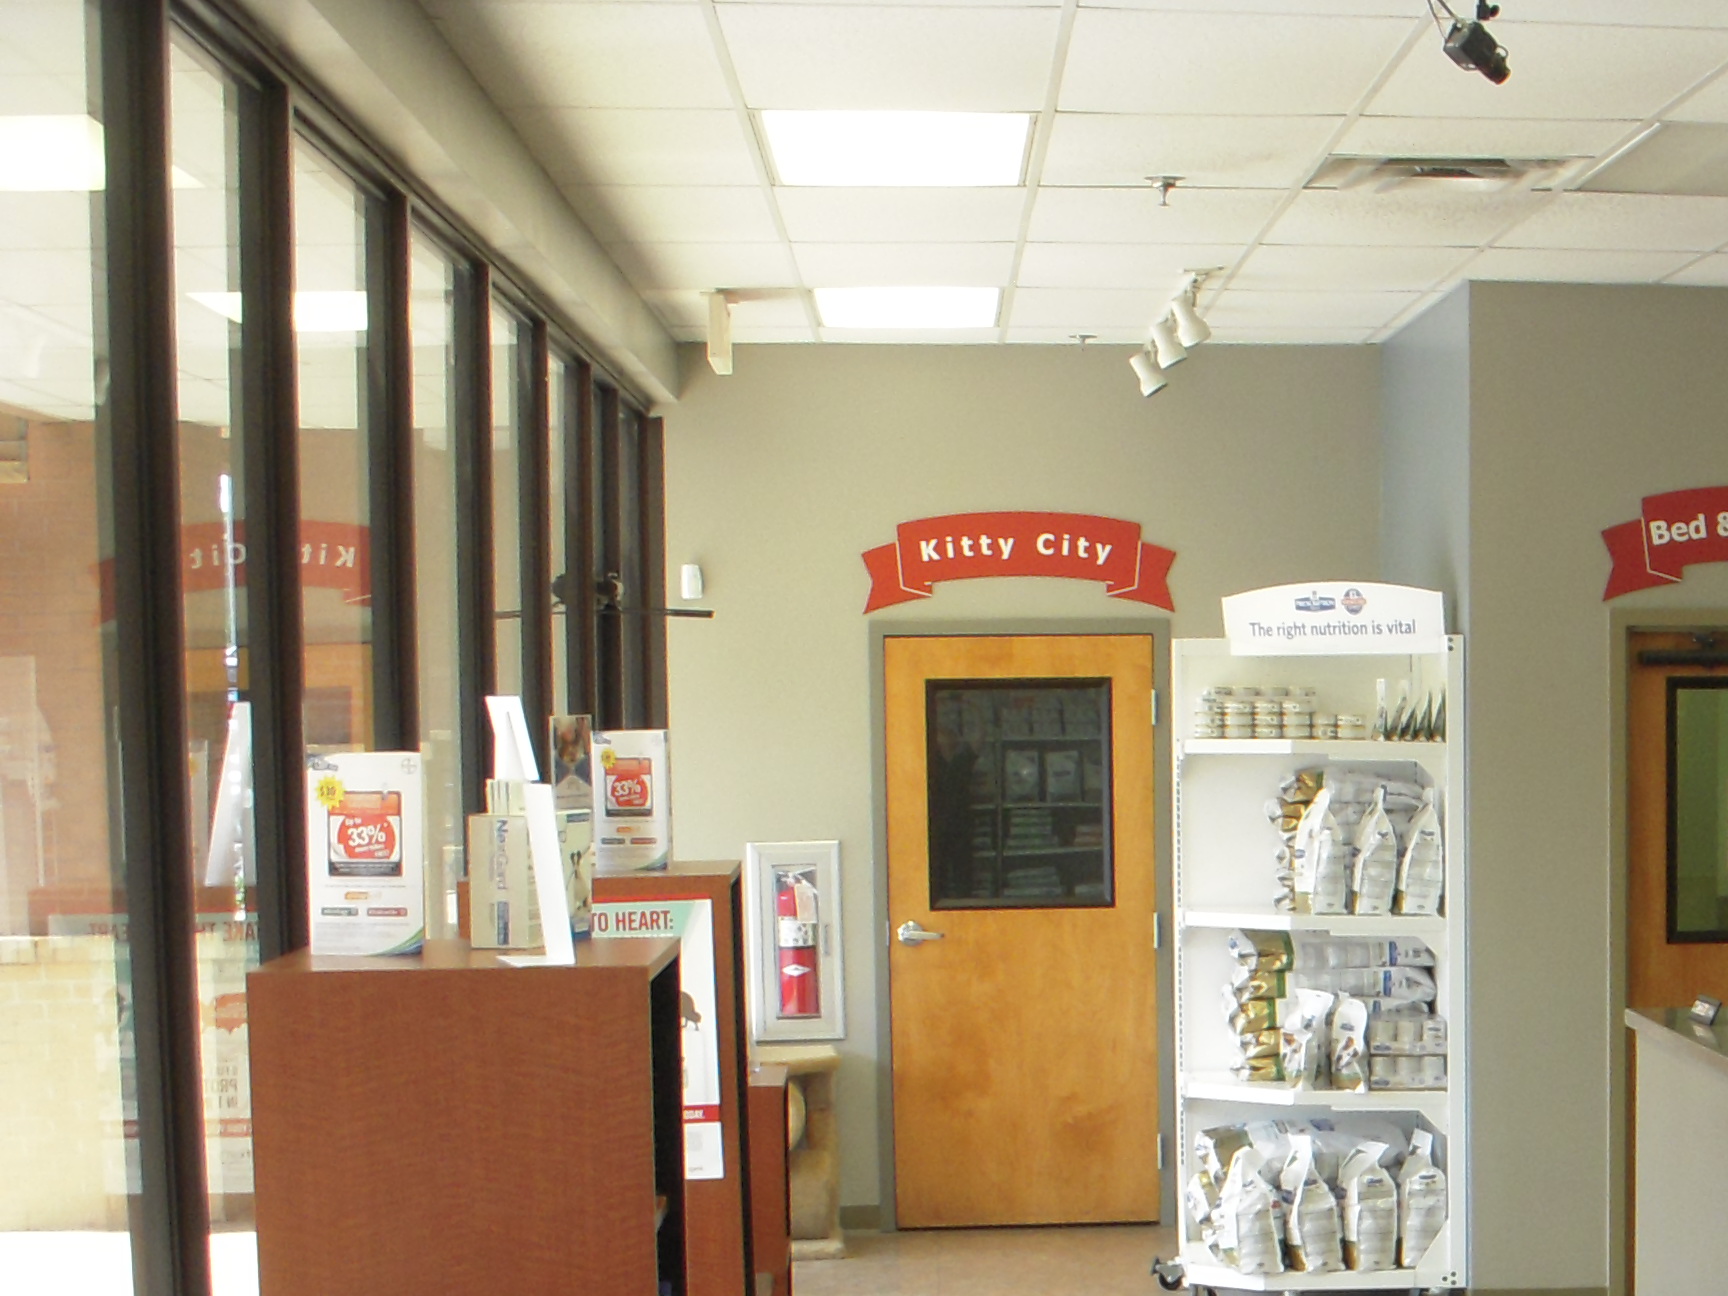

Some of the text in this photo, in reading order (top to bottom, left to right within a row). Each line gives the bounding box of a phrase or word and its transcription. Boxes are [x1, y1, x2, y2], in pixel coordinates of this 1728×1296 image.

[1649, 513, 1707, 546] Bed
[919, 533, 1112, 565] Kitty City
[1249, 619, 1416, 640] The right nutrition is vital
[613, 779, 641, 796] 33%
[347, 824, 386, 846] 33%
[591, 910, 674, 932] TO HEART:
